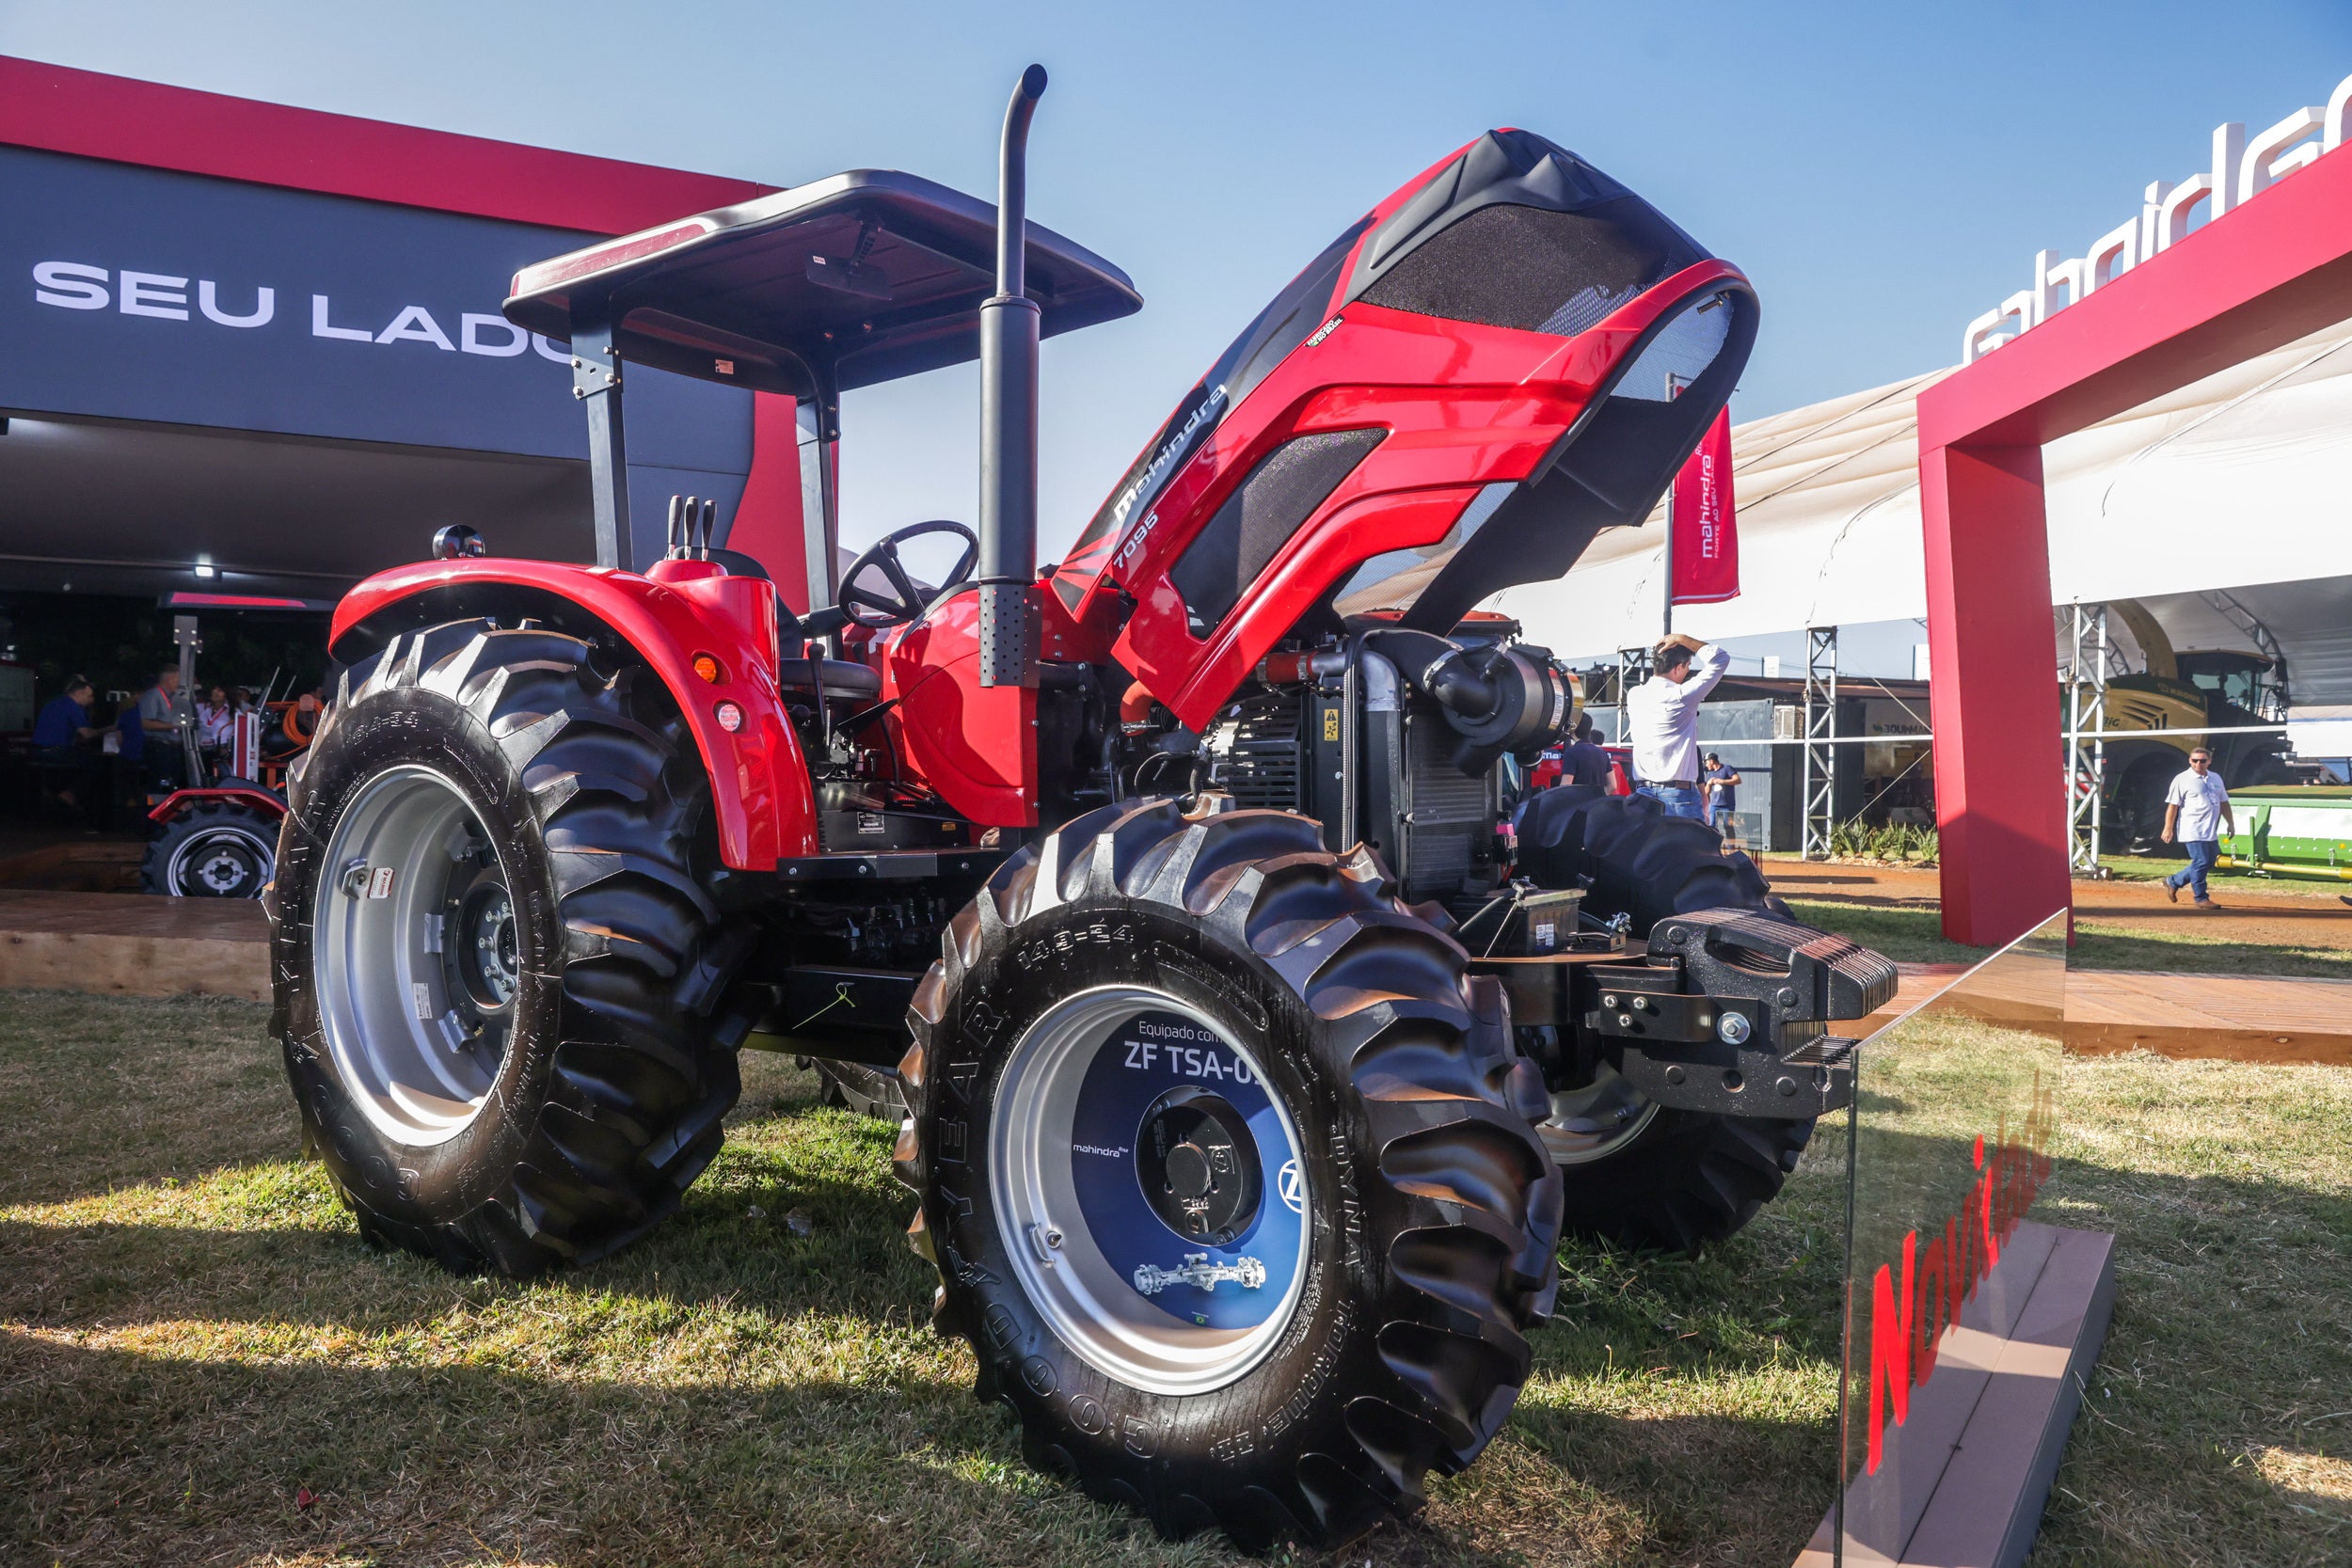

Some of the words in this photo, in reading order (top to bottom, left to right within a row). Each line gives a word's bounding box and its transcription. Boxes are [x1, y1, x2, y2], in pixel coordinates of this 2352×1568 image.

[32, 261, 275, 328] SEU
[1307, 320, 1334, 346] FABRICADO
[1317, 333, 1327, 342] NO
[1326, 318, 1343, 335] BRASIL
[1114, 384, 1228, 523] mahindra
[1699, 454, 1713, 559] mahindra
[1114, 511, 1159, 569] 7095
[1138, 1021, 1195, 1039] Equipado
[1124, 1040, 1158, 1069] ZF
[1165, 1045, 1263, 1085] TSA-0
[1073, 1144, 1120, 1158] mahindra
